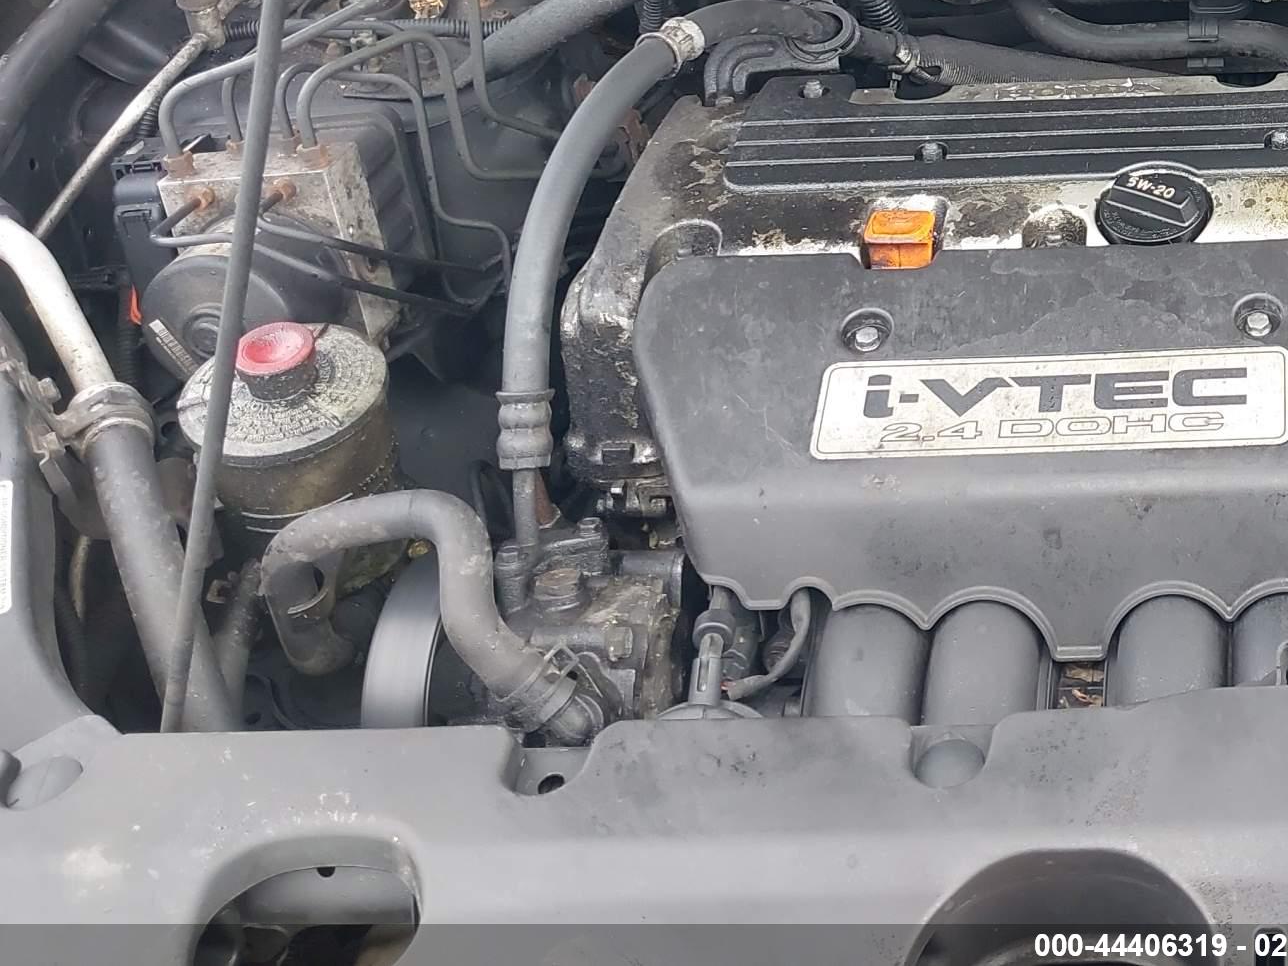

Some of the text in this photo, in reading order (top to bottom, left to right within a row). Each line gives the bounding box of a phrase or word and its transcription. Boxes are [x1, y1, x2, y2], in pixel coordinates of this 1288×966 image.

[1126, 175, 1176, 199] 5W-20
[862, 367, 1248, 418] i-VTEC
[880, 411, 1225, 443] 2.4 DOHC
